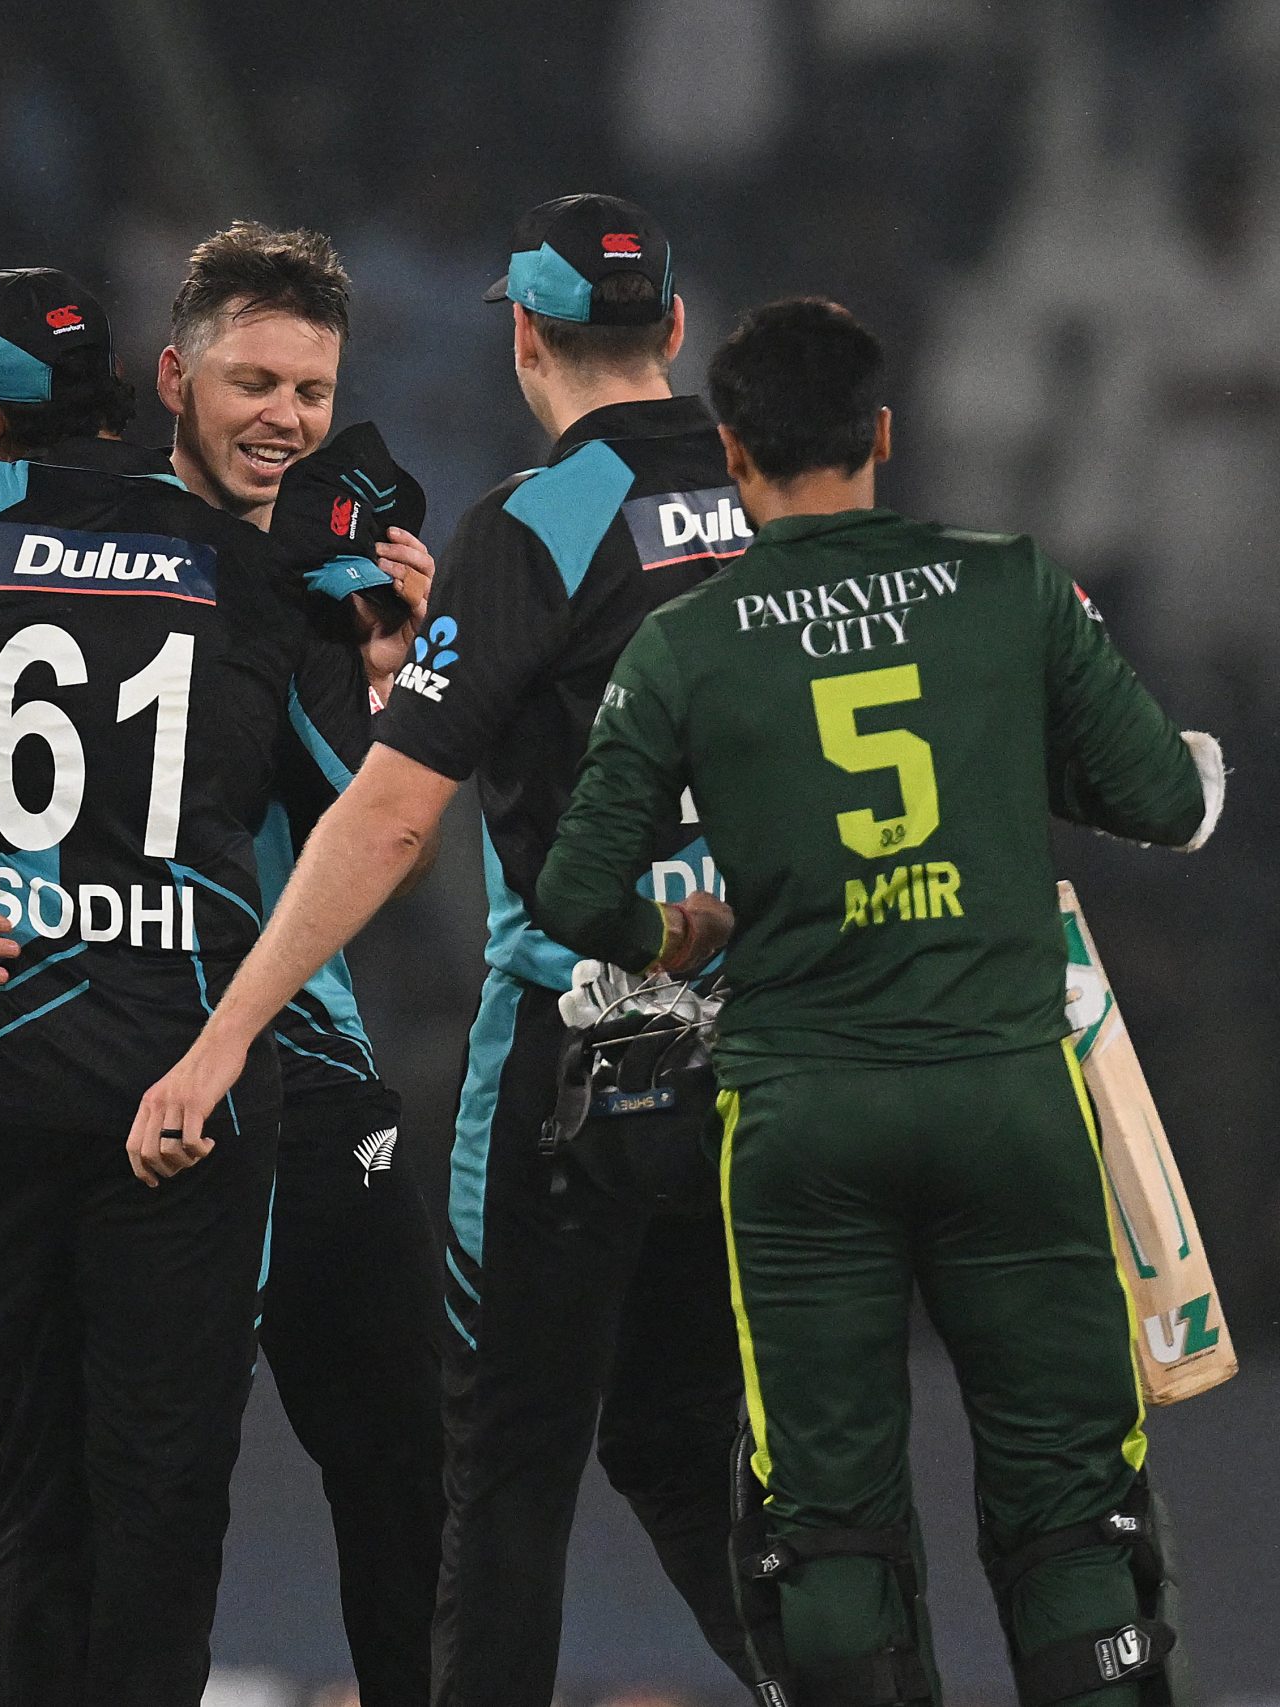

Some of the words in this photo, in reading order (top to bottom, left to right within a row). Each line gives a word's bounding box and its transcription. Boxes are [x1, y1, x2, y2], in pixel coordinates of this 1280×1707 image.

[349, 500, 361, 540] canterbury
[658, 498, 755, 548] Dulu
[13, 534, 185, 584] Dulux
[733, 559, 964, 633] PARKVIEW
[800, 606, 912, 659] CITY
[394, 662, 450, 702] ANZ
[809, 663, 941, 860] 5
[839, 861, 966, 934] AMIR
[611, 1096, 657, 1112] SHREY
[1143, 1291, 1221, 1364] UZ
